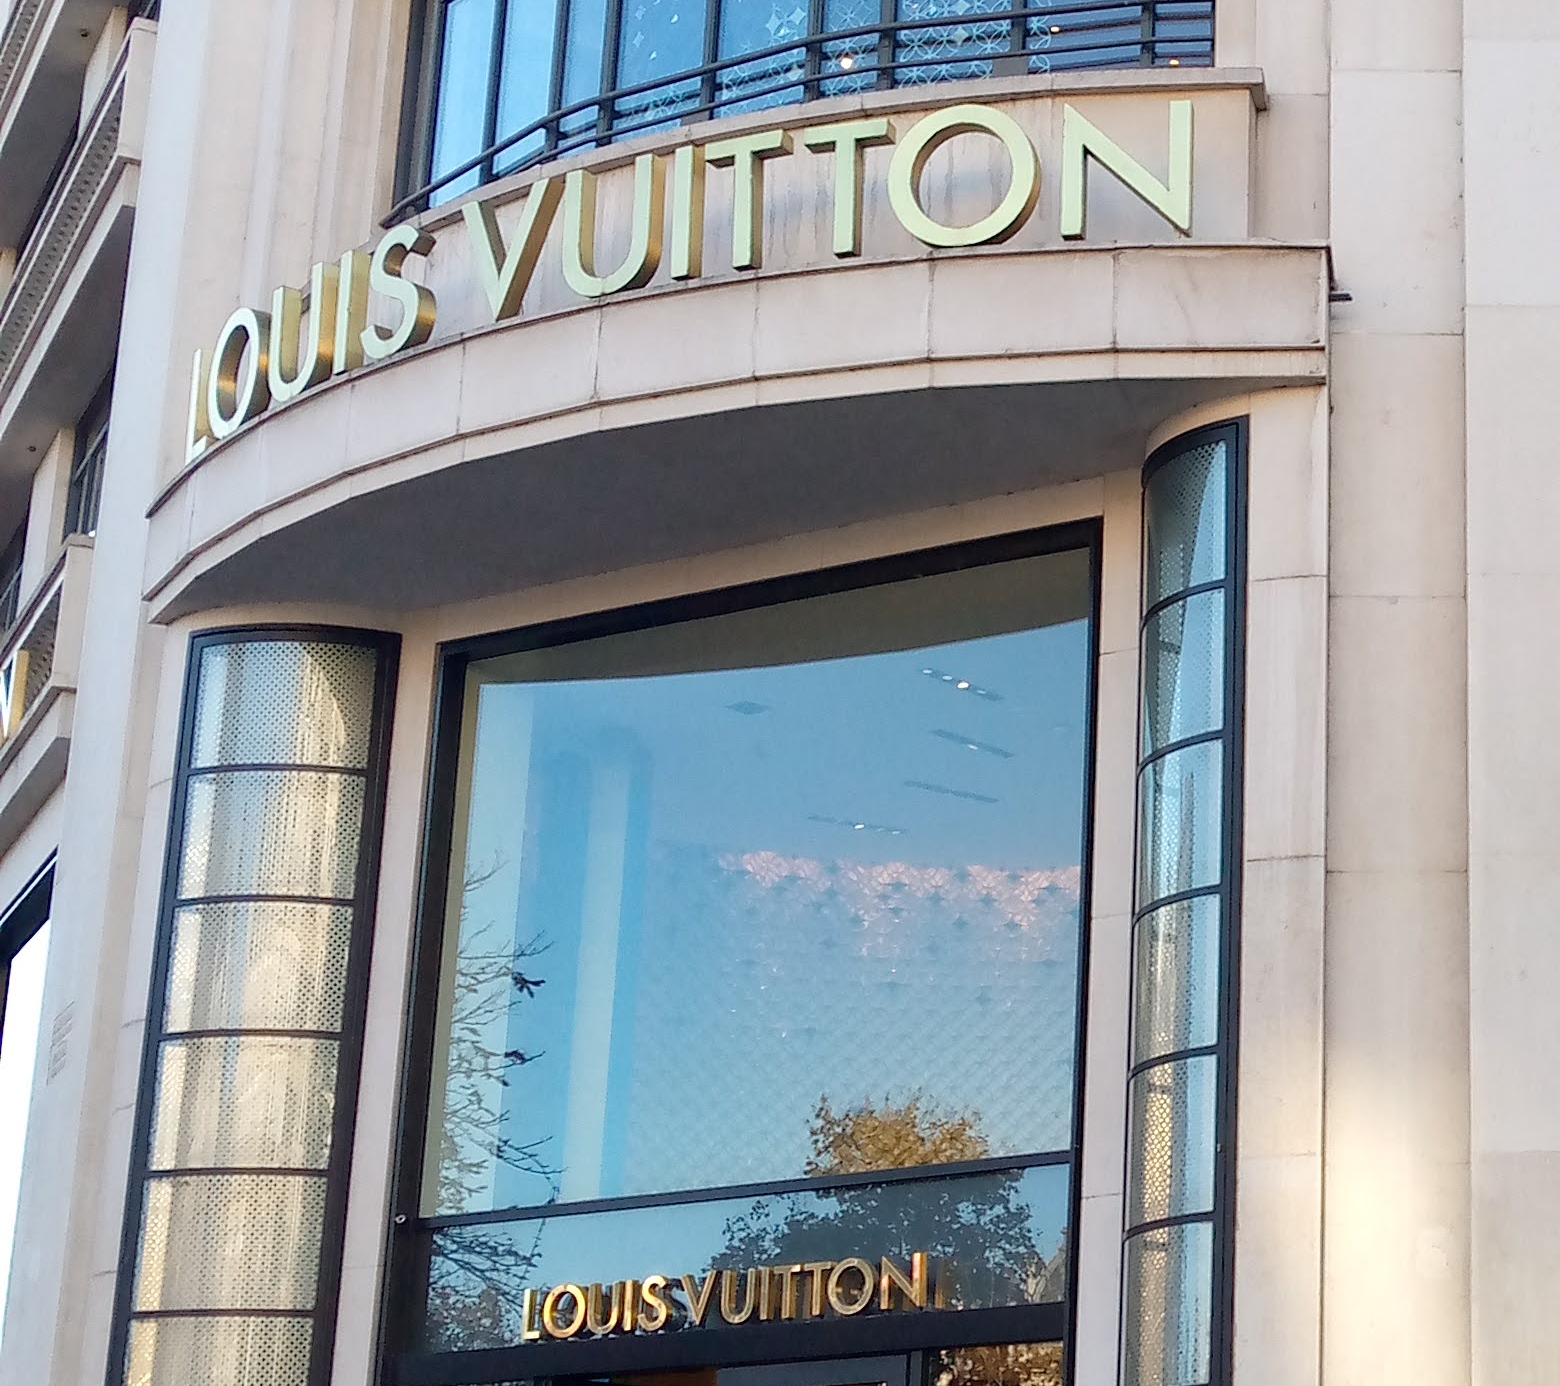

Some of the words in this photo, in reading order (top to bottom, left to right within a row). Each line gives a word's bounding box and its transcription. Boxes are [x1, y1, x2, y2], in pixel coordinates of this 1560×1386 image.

[186, 224, 437, 464] LOUIS
[461, 100, 1194, 319] VUITTON
[521, 1274, 672, 1341] LOUIS
[680, 1252, 928, 1327] VUITTON
